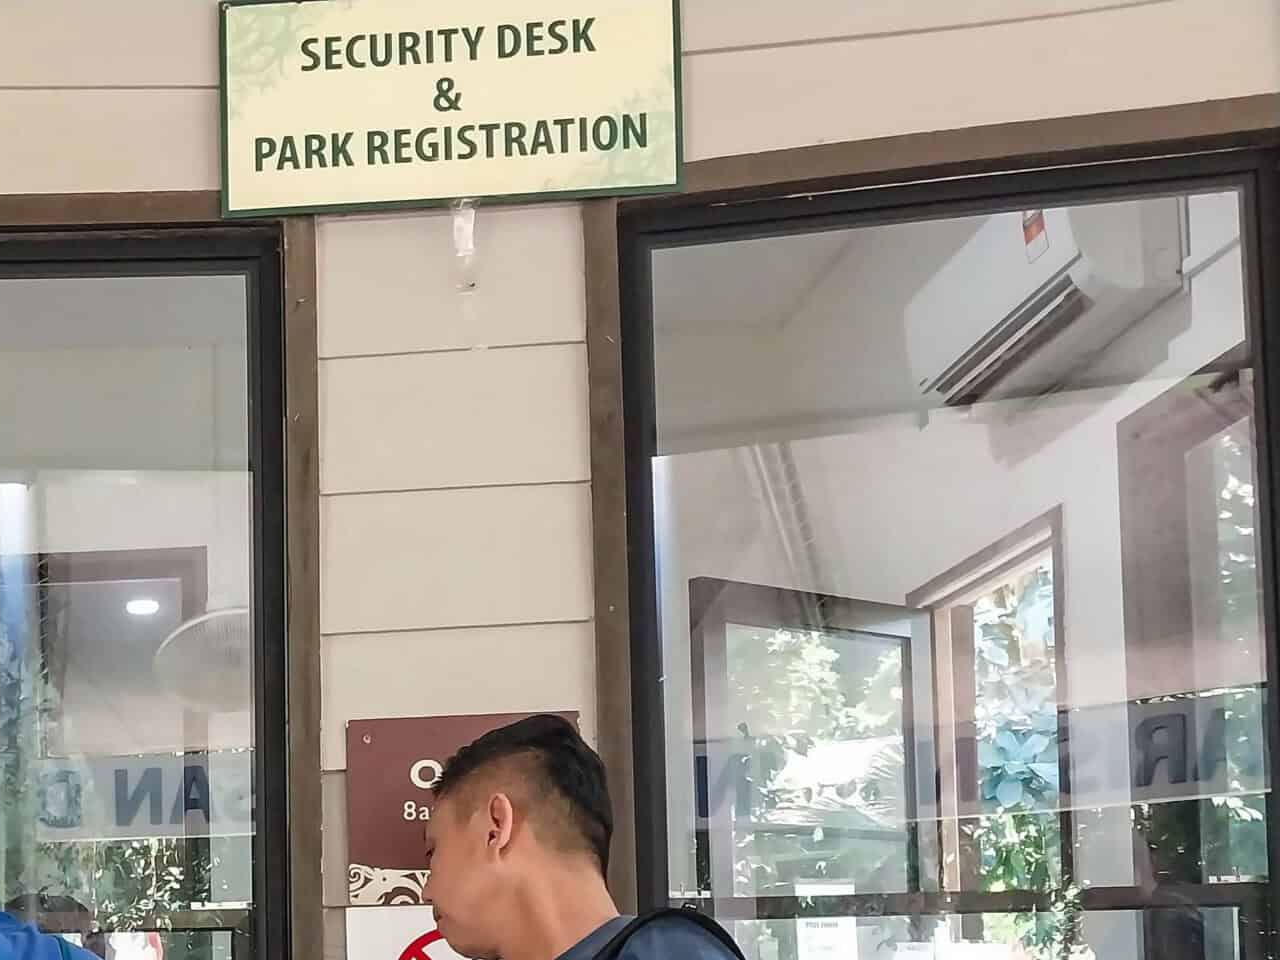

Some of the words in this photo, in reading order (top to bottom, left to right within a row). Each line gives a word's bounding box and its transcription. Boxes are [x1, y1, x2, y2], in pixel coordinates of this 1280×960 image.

[300, 26, 485, 72] SECURITY
[497, 17, 597, 59] DESK
[432, 77, 462, 112] &
[254, 131, 355, 172] PARK
[366, 112, 648, 166] REGISTRATION
[403, 800, 434, 821] 8a
